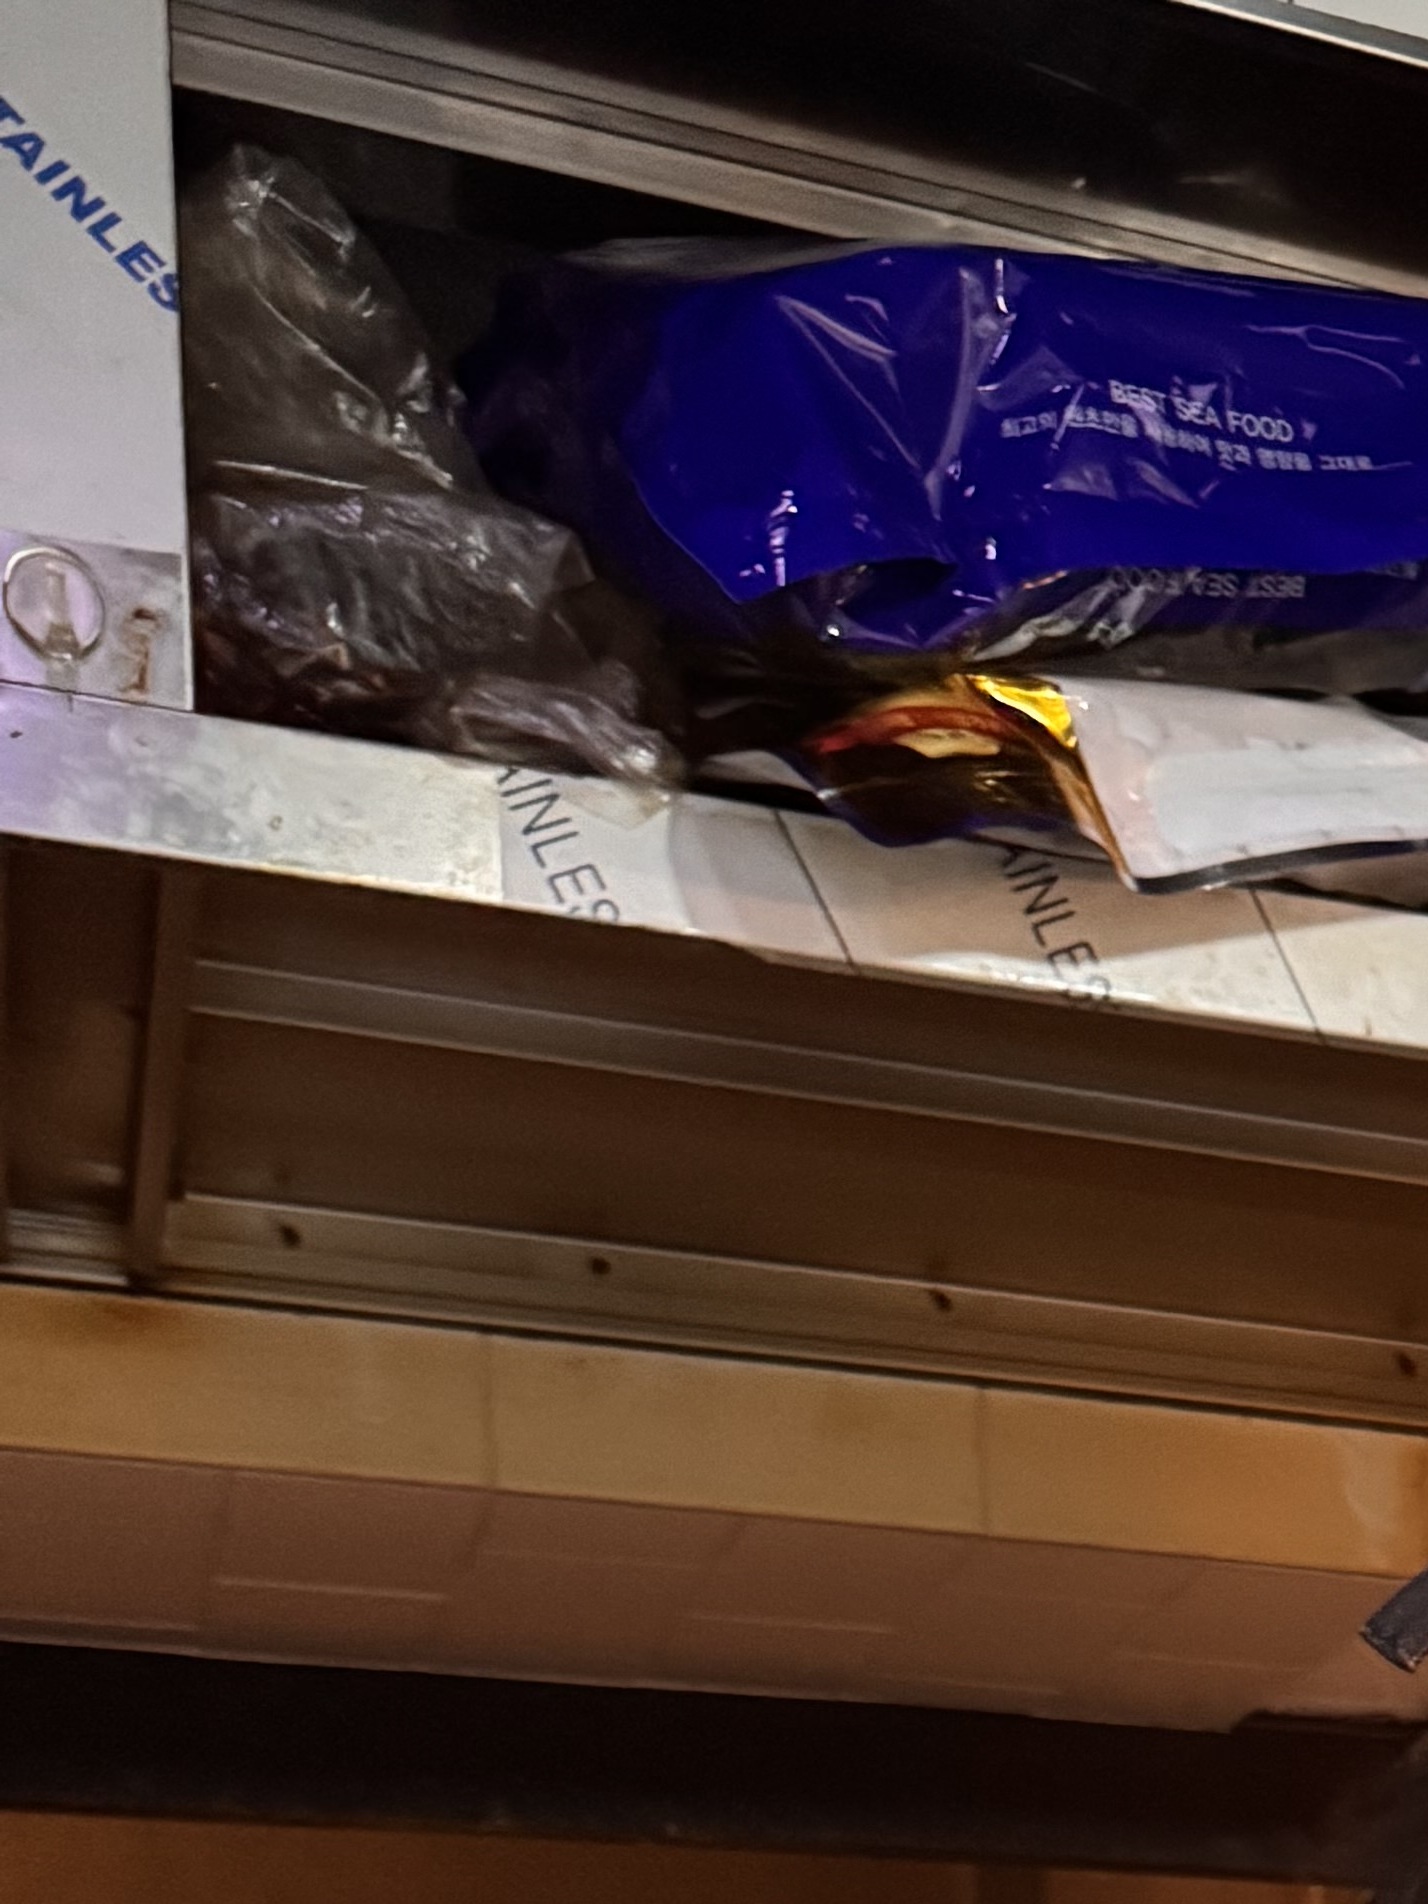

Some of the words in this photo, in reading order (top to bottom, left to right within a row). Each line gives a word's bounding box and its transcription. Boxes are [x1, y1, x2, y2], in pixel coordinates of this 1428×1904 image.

[1109, 379, 1167, 416] BEST
[1170, 396, 1222, 430] SEA
[1226, 409, 1296, 443] FOOD
